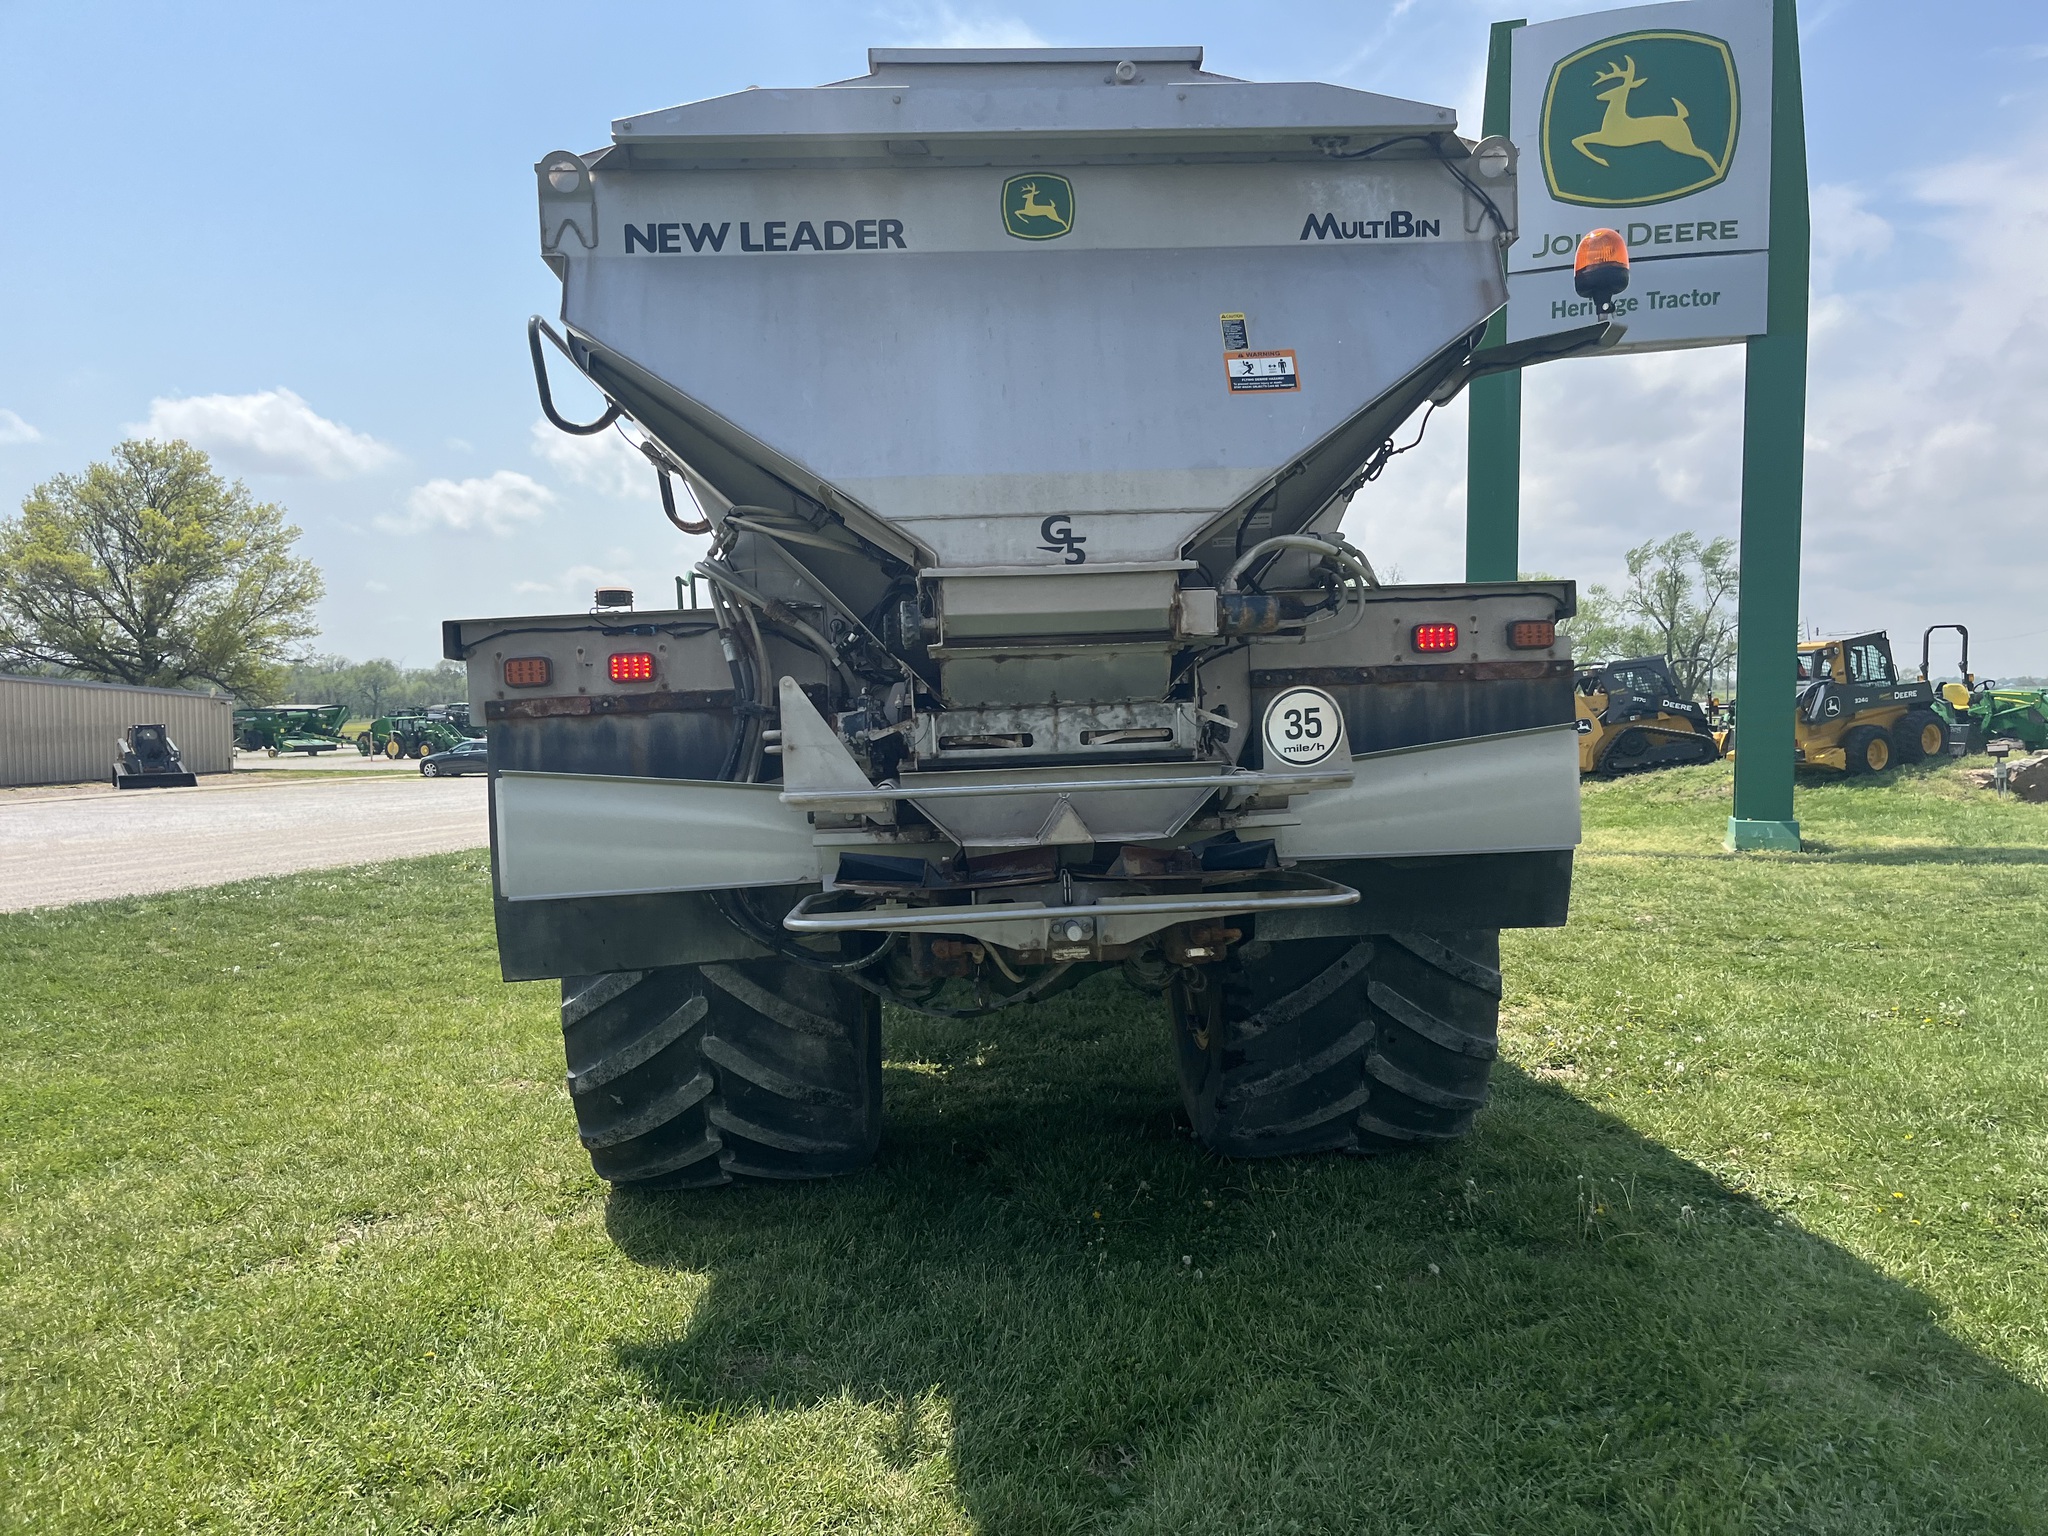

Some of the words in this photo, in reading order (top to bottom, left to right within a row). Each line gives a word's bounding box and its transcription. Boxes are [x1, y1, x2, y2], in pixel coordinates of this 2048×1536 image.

[624, 222, 731, 254] NEW
[740, 219, 907, 252] LEADER
[1532, 229, 1620, 258] JO
[1627, 220, 1738, 247] DEERE
[1551, 297, 1639, 319] Herige
[1646, 289, 1721, 309] Tractor
[1245, 350, 1281, 358] WARNING
[1662, 699, 1693, 712] DEERE
[1894, 690, 1918, 700] DEERE
[1284, 707, 1322, 740] 35
[1284, 743, 1325, 753] mile/h
